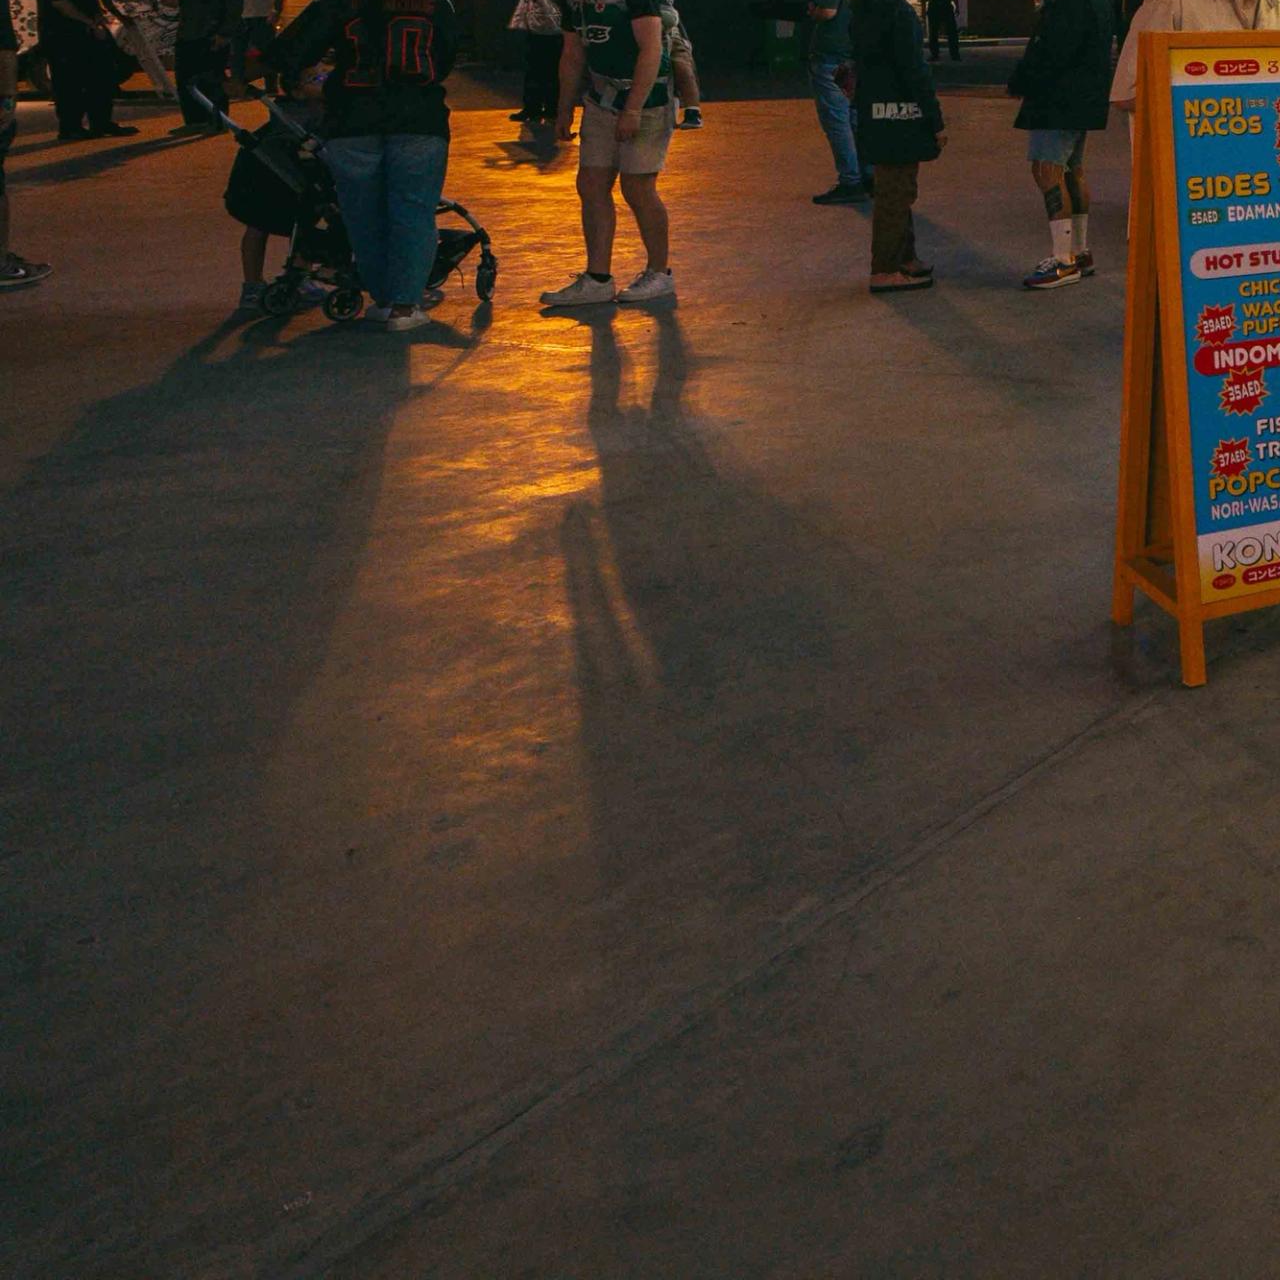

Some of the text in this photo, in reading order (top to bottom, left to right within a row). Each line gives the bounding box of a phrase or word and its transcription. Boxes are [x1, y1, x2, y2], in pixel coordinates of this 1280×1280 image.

[1219, 63, 1257, 74] コンビニ
[1184, 97, 1242, 118] NORI
[1185, 116, 1262, 137] TACOS
[1187, 172, 1271, 200] SIDES
[1191, 210, 1218, 224] 25AED
[1204, 252, 1246, 271] HOT
[1203, 317, 1232, 333] 29AED
[1228, 381, 1261, 403] 35AED
[1219, 450, 1247, 468] 37AED
